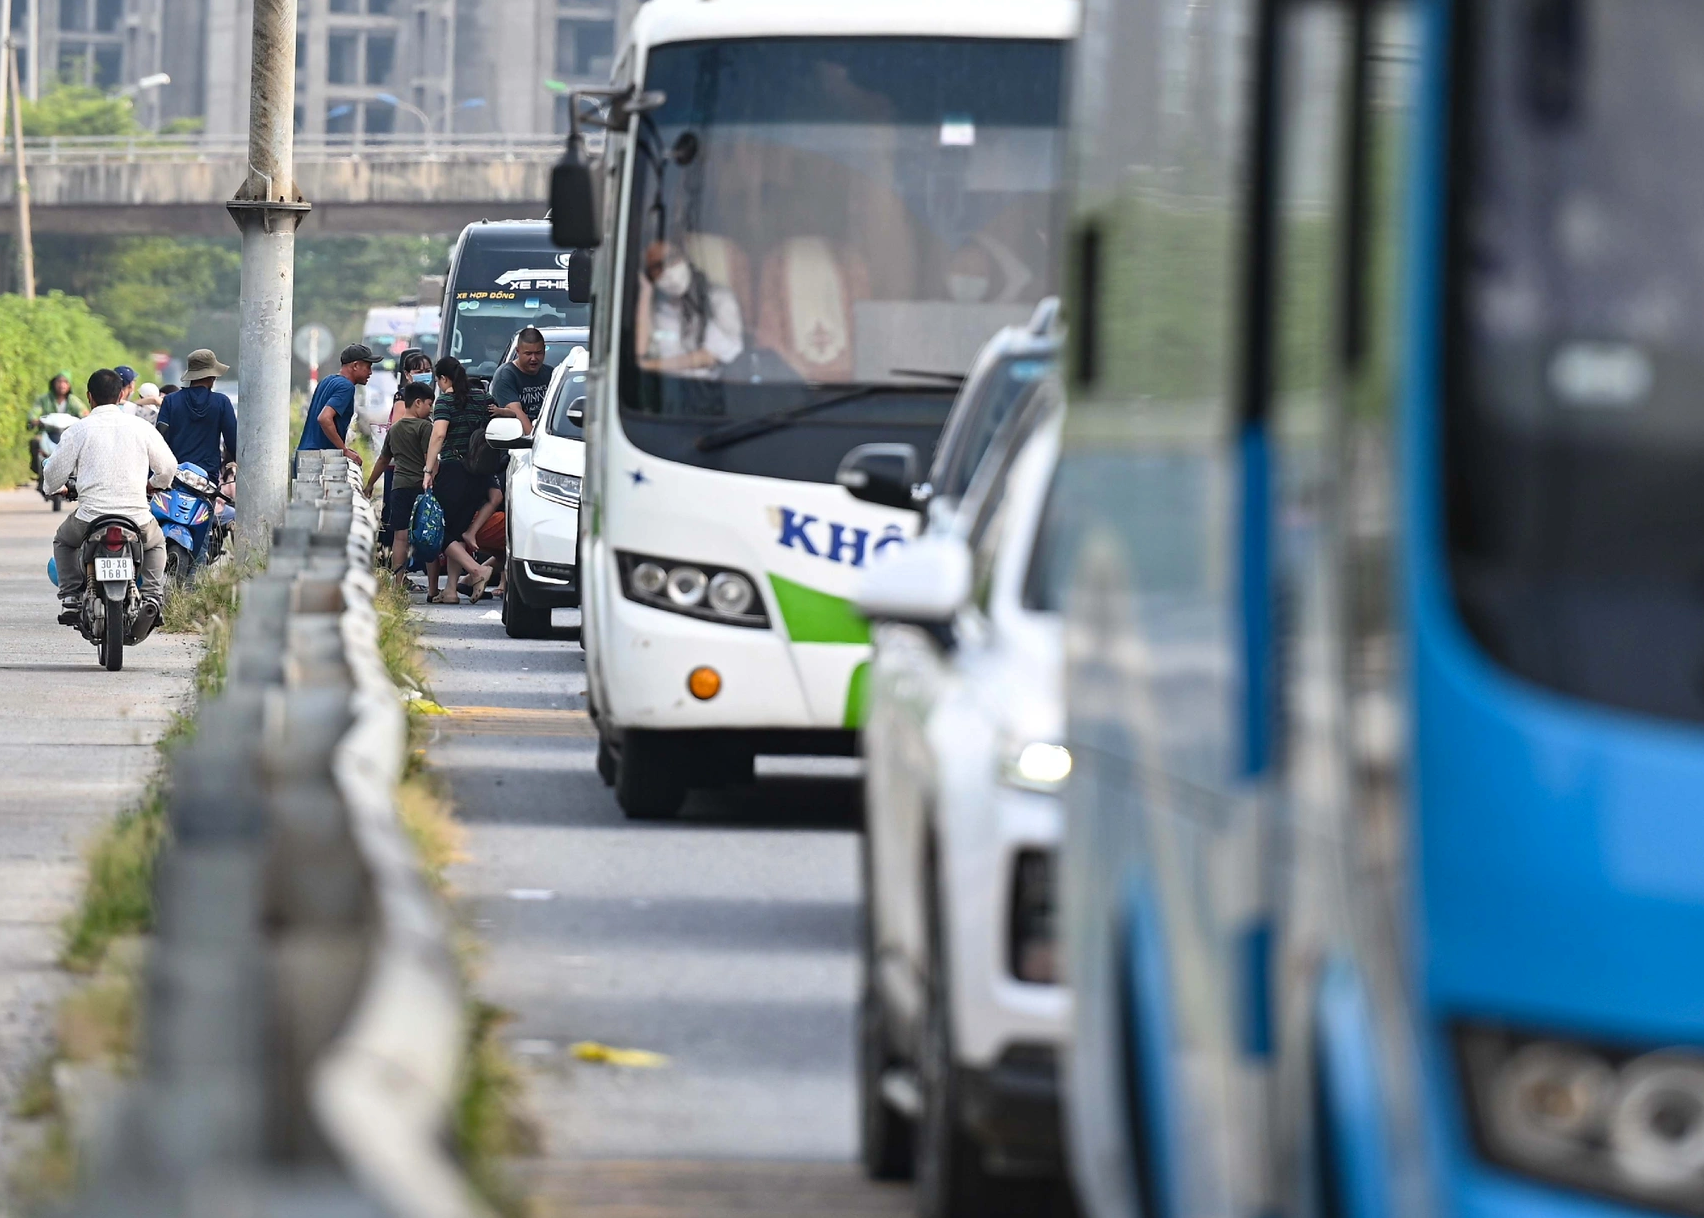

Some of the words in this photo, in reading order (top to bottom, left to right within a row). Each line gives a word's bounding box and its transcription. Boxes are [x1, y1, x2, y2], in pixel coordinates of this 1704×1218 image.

[510, 280, 532, 290] XE
[469, 291, 488, 299] HỢP
[102, 568, 128, 579] 1681
